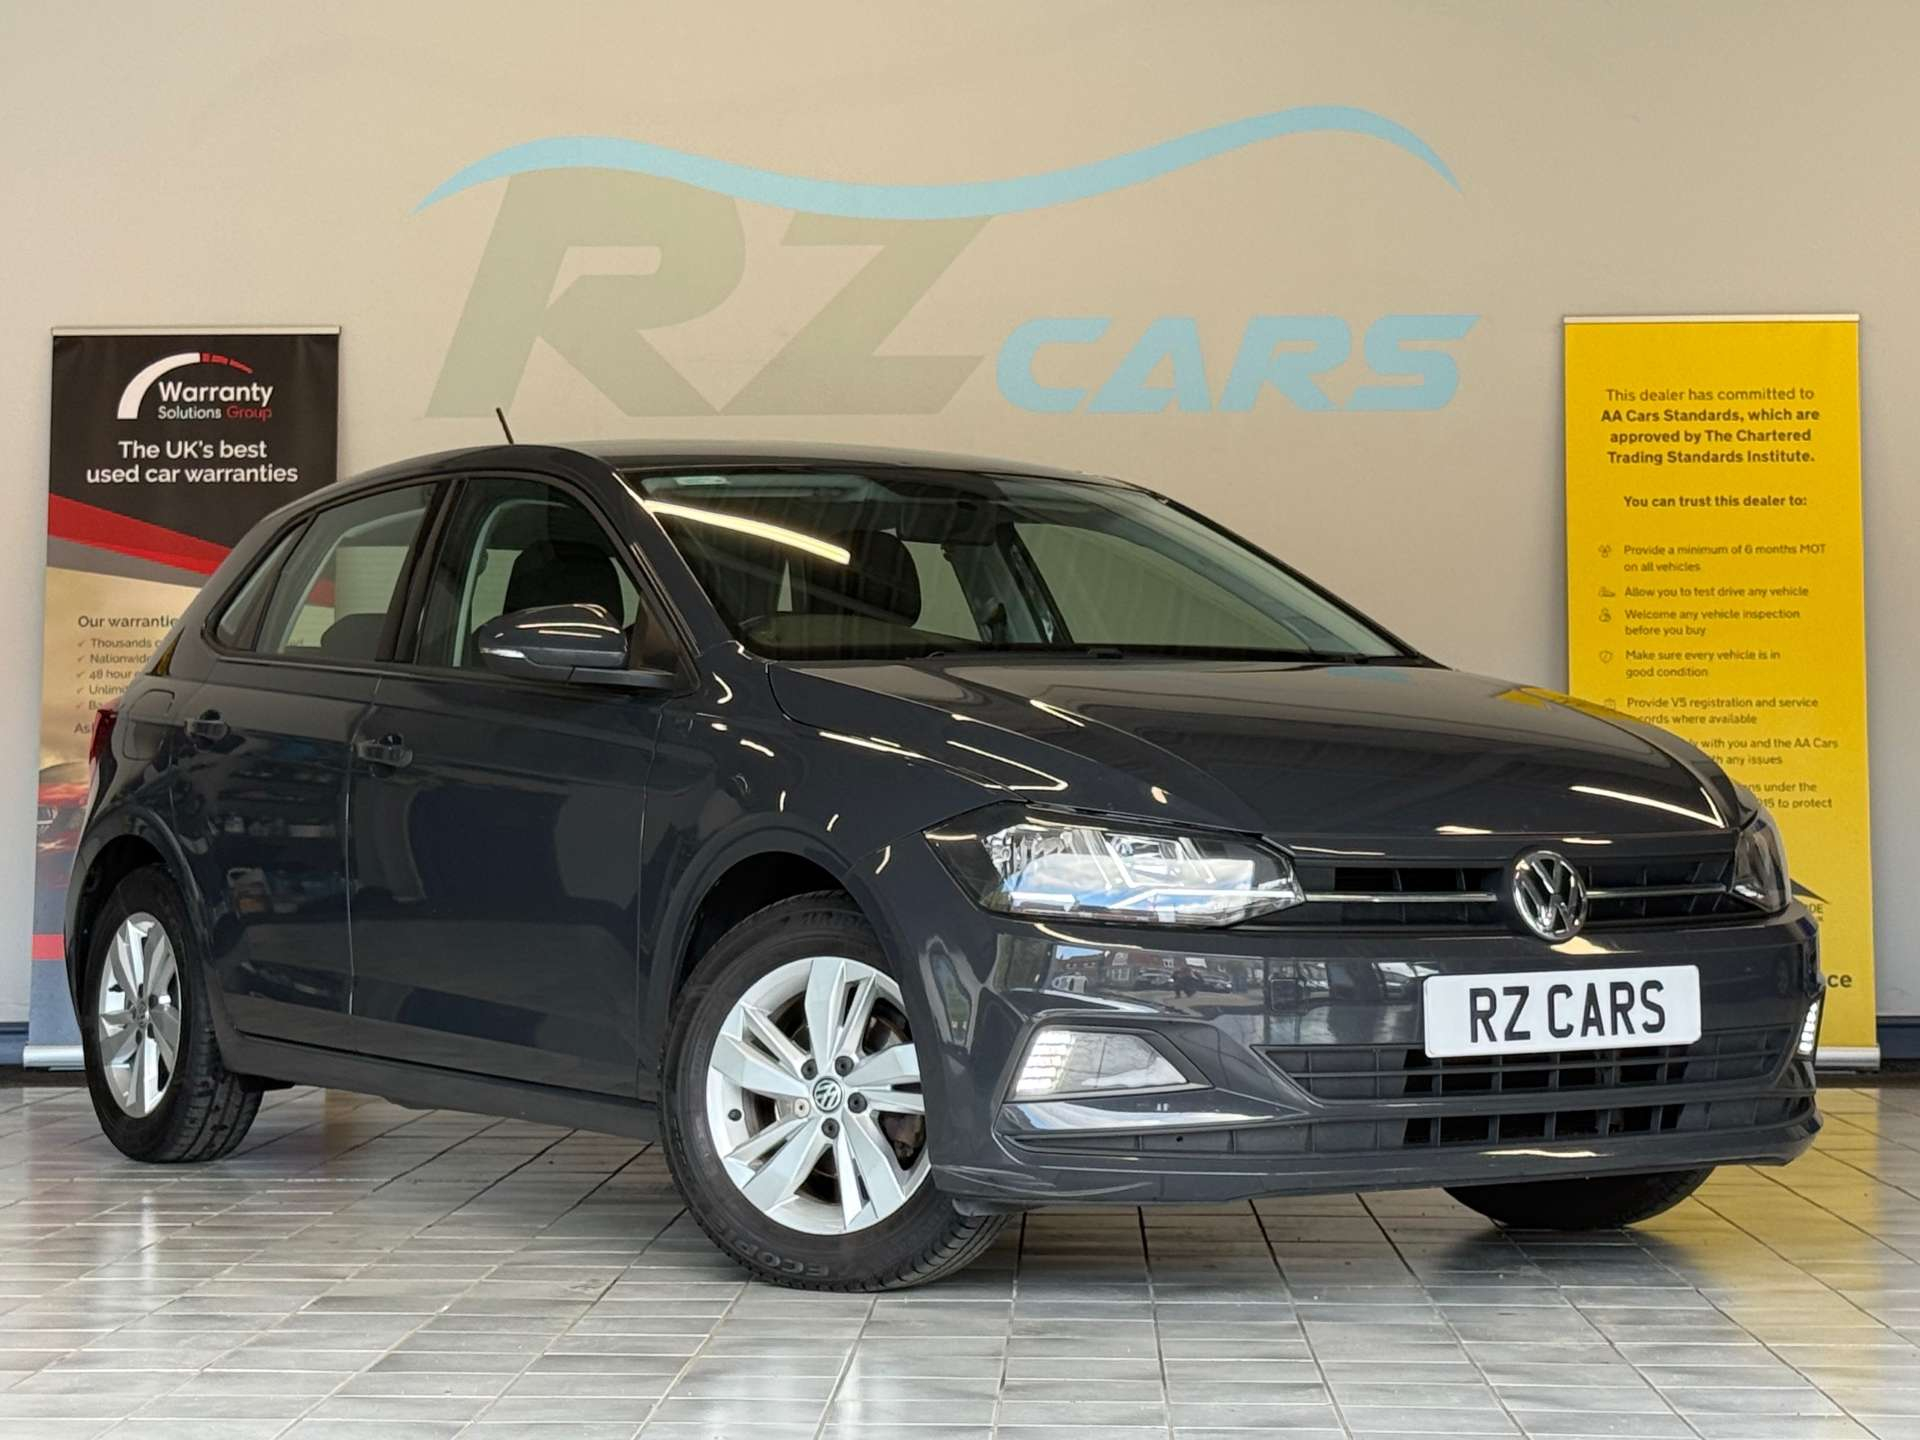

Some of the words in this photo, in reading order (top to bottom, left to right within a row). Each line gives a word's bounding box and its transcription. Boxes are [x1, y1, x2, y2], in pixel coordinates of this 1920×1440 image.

[424, 166, 996, 417] RZ
[996, 314, 1481, 413] CARS
[158, 381, 273, 406] Warranty
[1606, 389, 1635, 401] This
[1640, 389, 1683, 401] dealer
[1689, 389, 1713, 400] has
[1717, 388, 1795, 400] committed
[1800, 388, 1814, 400] to
[158, 406, 222, 419] Solutions
[226, 406, 272, 422] Group
[1601, 410, 1622, 422] AA
[1626, 410, 1659, 422] Cars
[1664, 410, 1744, 424] Standards,
[1748, 409, 1792, 420] which
[1796, 410, 1820, 420] are
[1610, 431, 1680, 445] approved
[1684, 431, 1701, 444] by
[1704, 430, 1732, 442] The
[1736, 429, 1811, 442] Chartered
[118, 441, 160, 458] The
[166, 441, 214, 458] UK's
[219, 440, 267, 458] best
[1607, 452, 1663, 465] Trading
[1667, 451, 1743, 463] Standards
[1747, 451, 1815, 462] Institute.
[87, 465, 139, 483] used
[145, 468, 181, 483] car
[184, 465, 298, 482] warranties
[1624, 496, 1648, 508] You
[1652, 498, 1675, 508] can
[1679, 496, 1711, 507] trust
[1715, 496, 1740, 507] this
[1743, 496, 1785, 507] dealer
[1789, 496, 1807, 507] to:
[1624, 545, 1665, 555] Provide
[1677, 545, 1728, 555] minimum
[1731, 545, 1742, 554] of
[1755, 545, 1797, 554] months
[1800, 544, 1826, 554] MOT
[1641, 563, 1653, 571] all
[1656, 563, 1701, 572] vehicles
[1624, 587, 1656, 597] Allow
[1658, 589, 1677, 598] you
[1680, 588, 1692, 596] to
[1694, 588, 1715, 596] test
[1718, 587, 1745, 596] drive
[1748, 588, 1766, 598] any
[1769, 587, 1809, 596] vehicle
[1625, 610, 1676, 619] Welcome
[1679, 611, 1698, 620] any
[1701, 609, 1740, 619] vehicle
[1743, 609, 1800, 620] inspection
[78, 616, 105, 627] Our
[1625, 625, 1660, 635] before
[1664, 628, 1683, 637] you
[1686, 625, 1705, 637] buy
[91, 638, 152, 648] Thousands
[1626, 650, 1655, 661] Make
[1659, 652, 1681, 661] sure
[1685, 652, 1714, 662] every
[1717, 650, 1755, 660] vehicle
[1758, 650, 1768, 659] is
[1770, 650, 1780, 659] in
[89, 671, 104, 679] 48
[1626, 668, 1653, 679] good
[1657, 667, 1708, 676] condition
[1627, 698, 1667, 708] Provide
[1671, 697, 1687, 707] V5
[1690, 697, 1753, 709] registration
[1756, 697, 1776, 707] and
[1779, 698, 1818, 707] service
[1672, 714, 1704, 724] where
[1708, 714, 1757, 724] available
[1702, 739, 1725, 748] with
[1727, 740, 1748, 749] you
[1751, 739, 1771, 748] and
[1774, 738, 1790, 748] the
[1794, 738, 1810, 748] AA
[1813, 738, 1838, 748] Cars
[1726, 756, 1745, 765] any
[1748, 755, 1783, 765] issues
[1764, 782, 1794, 792] under
[1798, 782, 1817, 792] the
[1778, 798, 1789, 808] to
[1792, 798, 1832, 809] protect
[1828, 974, 1852, 987] ce
[1470, 986, 1531, 1042] RZ
[1548, 980, 1666, 1038] CARS
